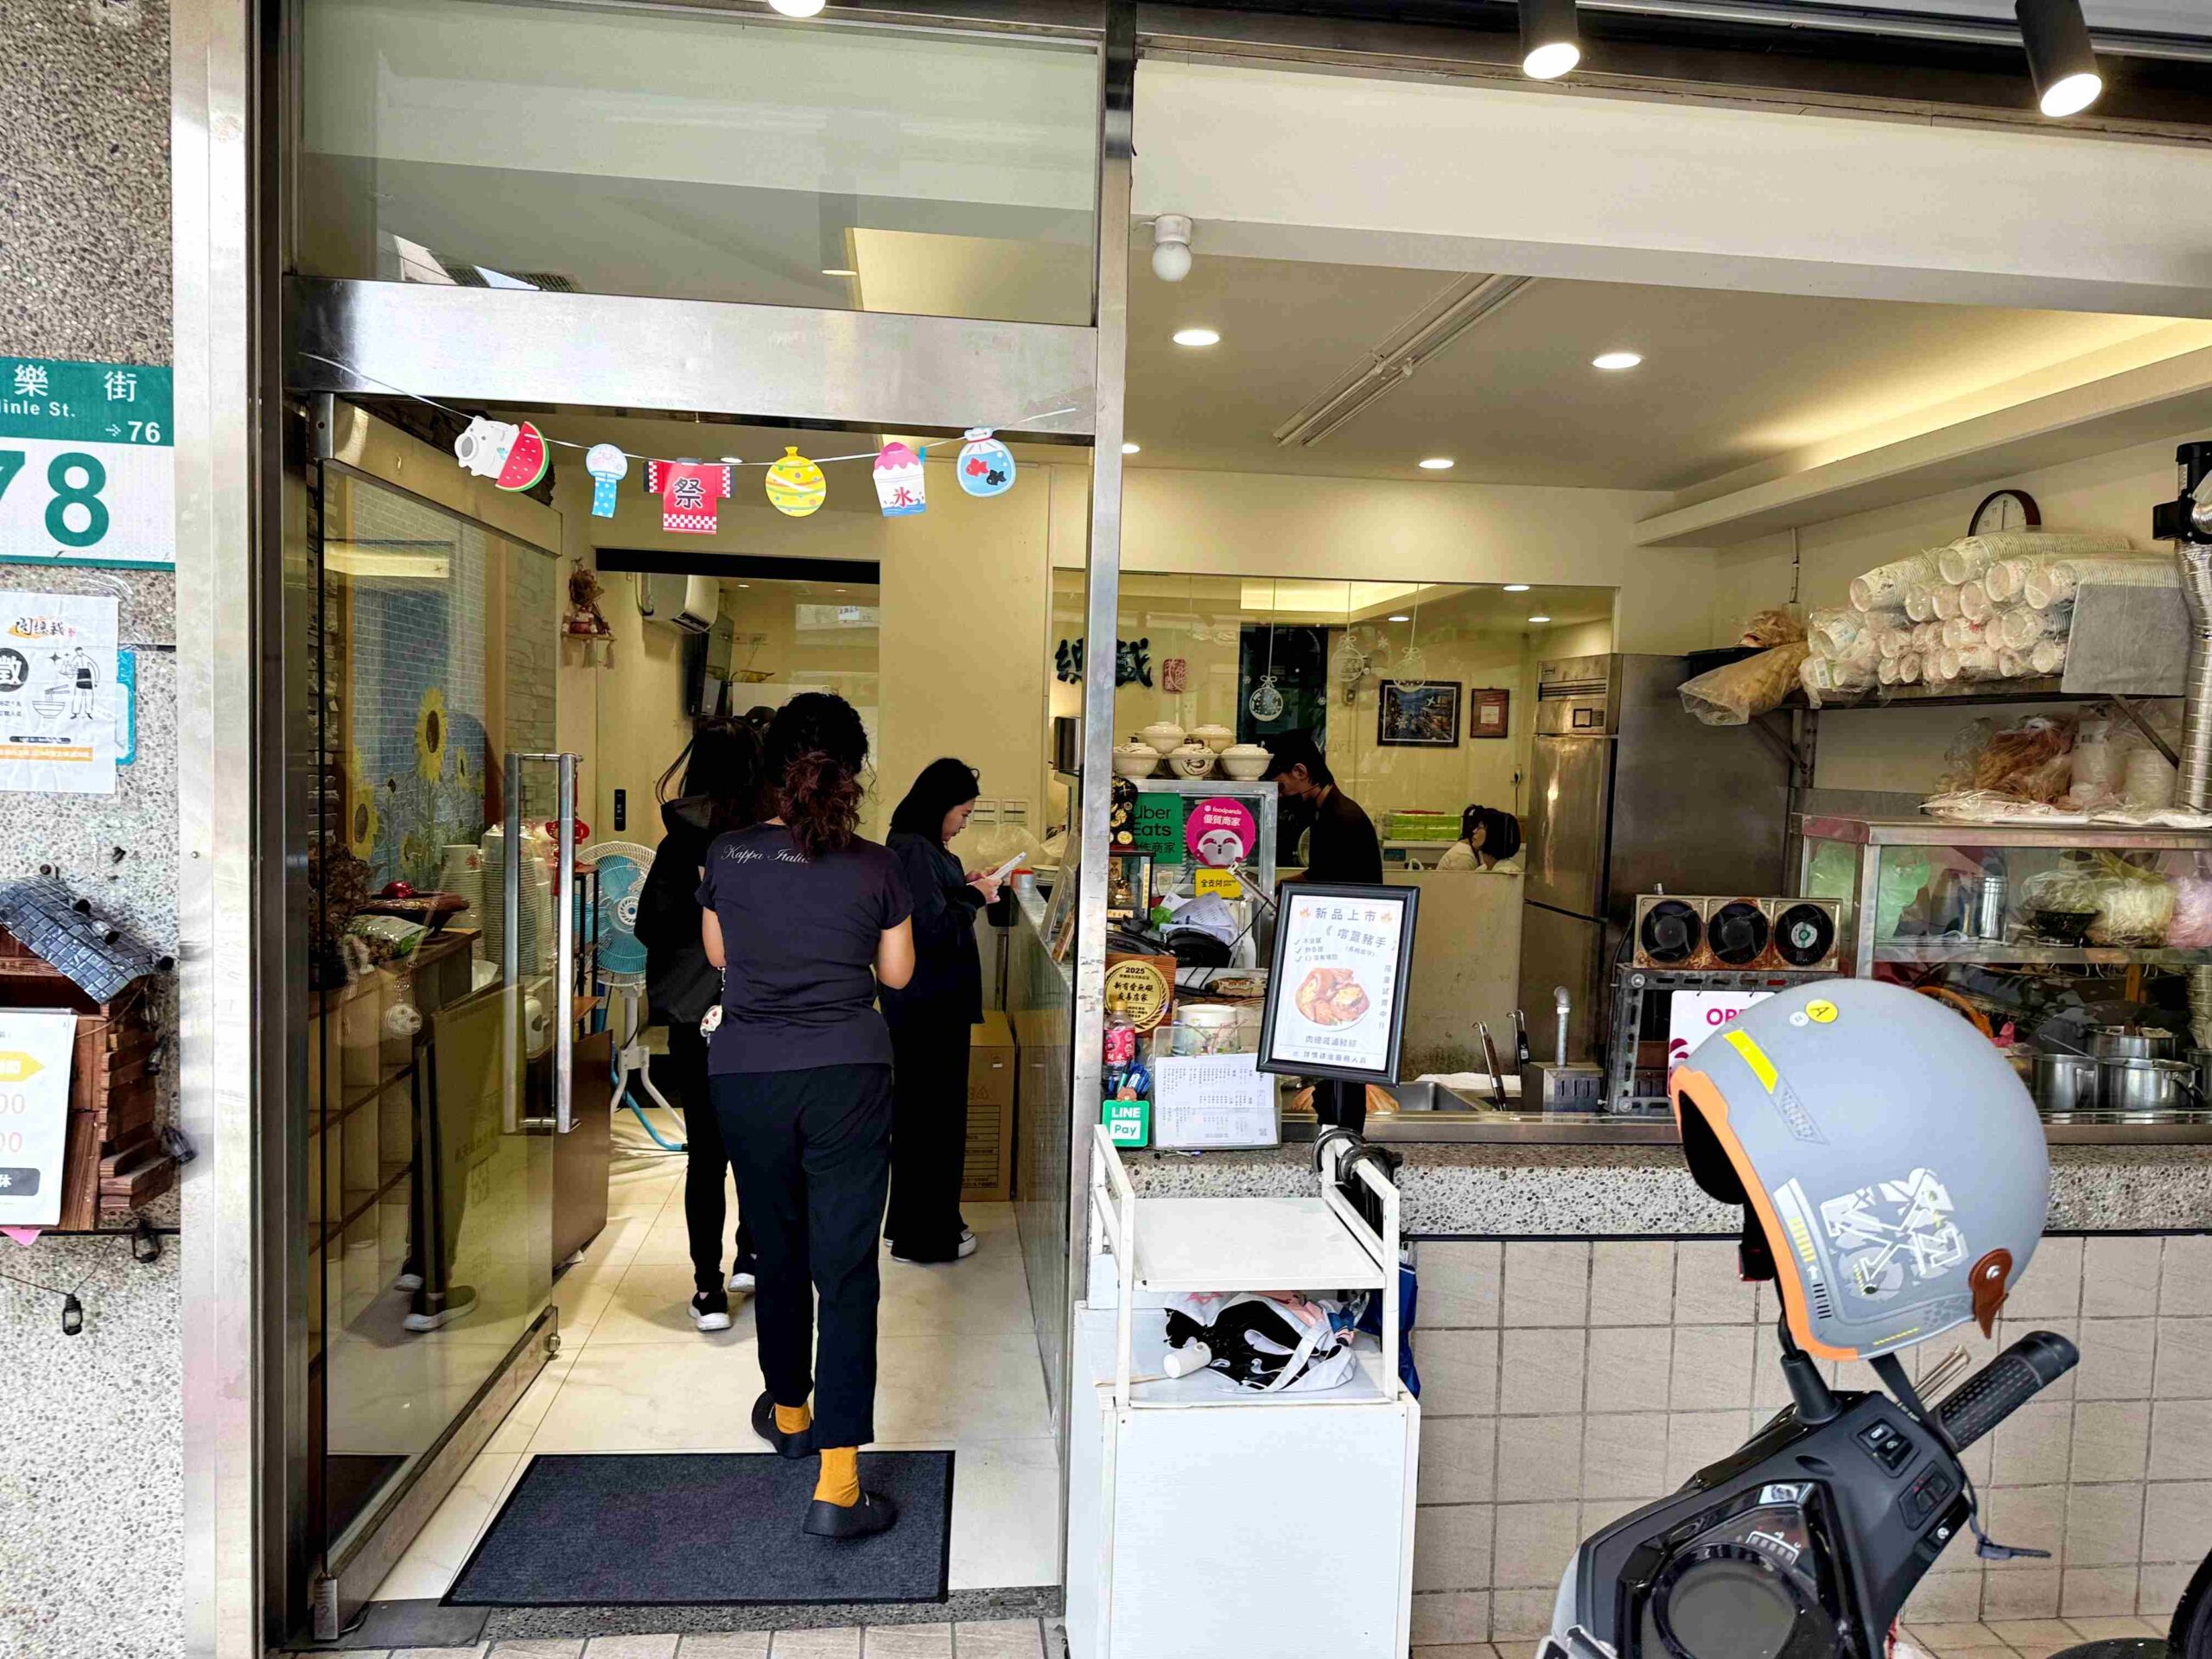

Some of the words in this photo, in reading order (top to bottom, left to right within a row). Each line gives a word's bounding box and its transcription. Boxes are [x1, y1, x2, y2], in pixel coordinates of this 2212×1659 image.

[0, 398, 41, 416] inle
[48, 401, 76, 417] St.
[127, 420, 161, 443] 76
[673, 475, 704, 509] 祭
[1212, 806, 1243, 815] foodpanda
[1203, 814, 1242, 827] 優質商家
[721, 844, 764, 864] Kappa
[1200, 879, 1224, 888] 全支付
[1315, 906, 1377, 923] 新品上市
[1125, 966, 1146, 975] 2025
[1111, 1107, 1141, 1118] LINE
[1115, 1124, 1137, 1136] Pay
